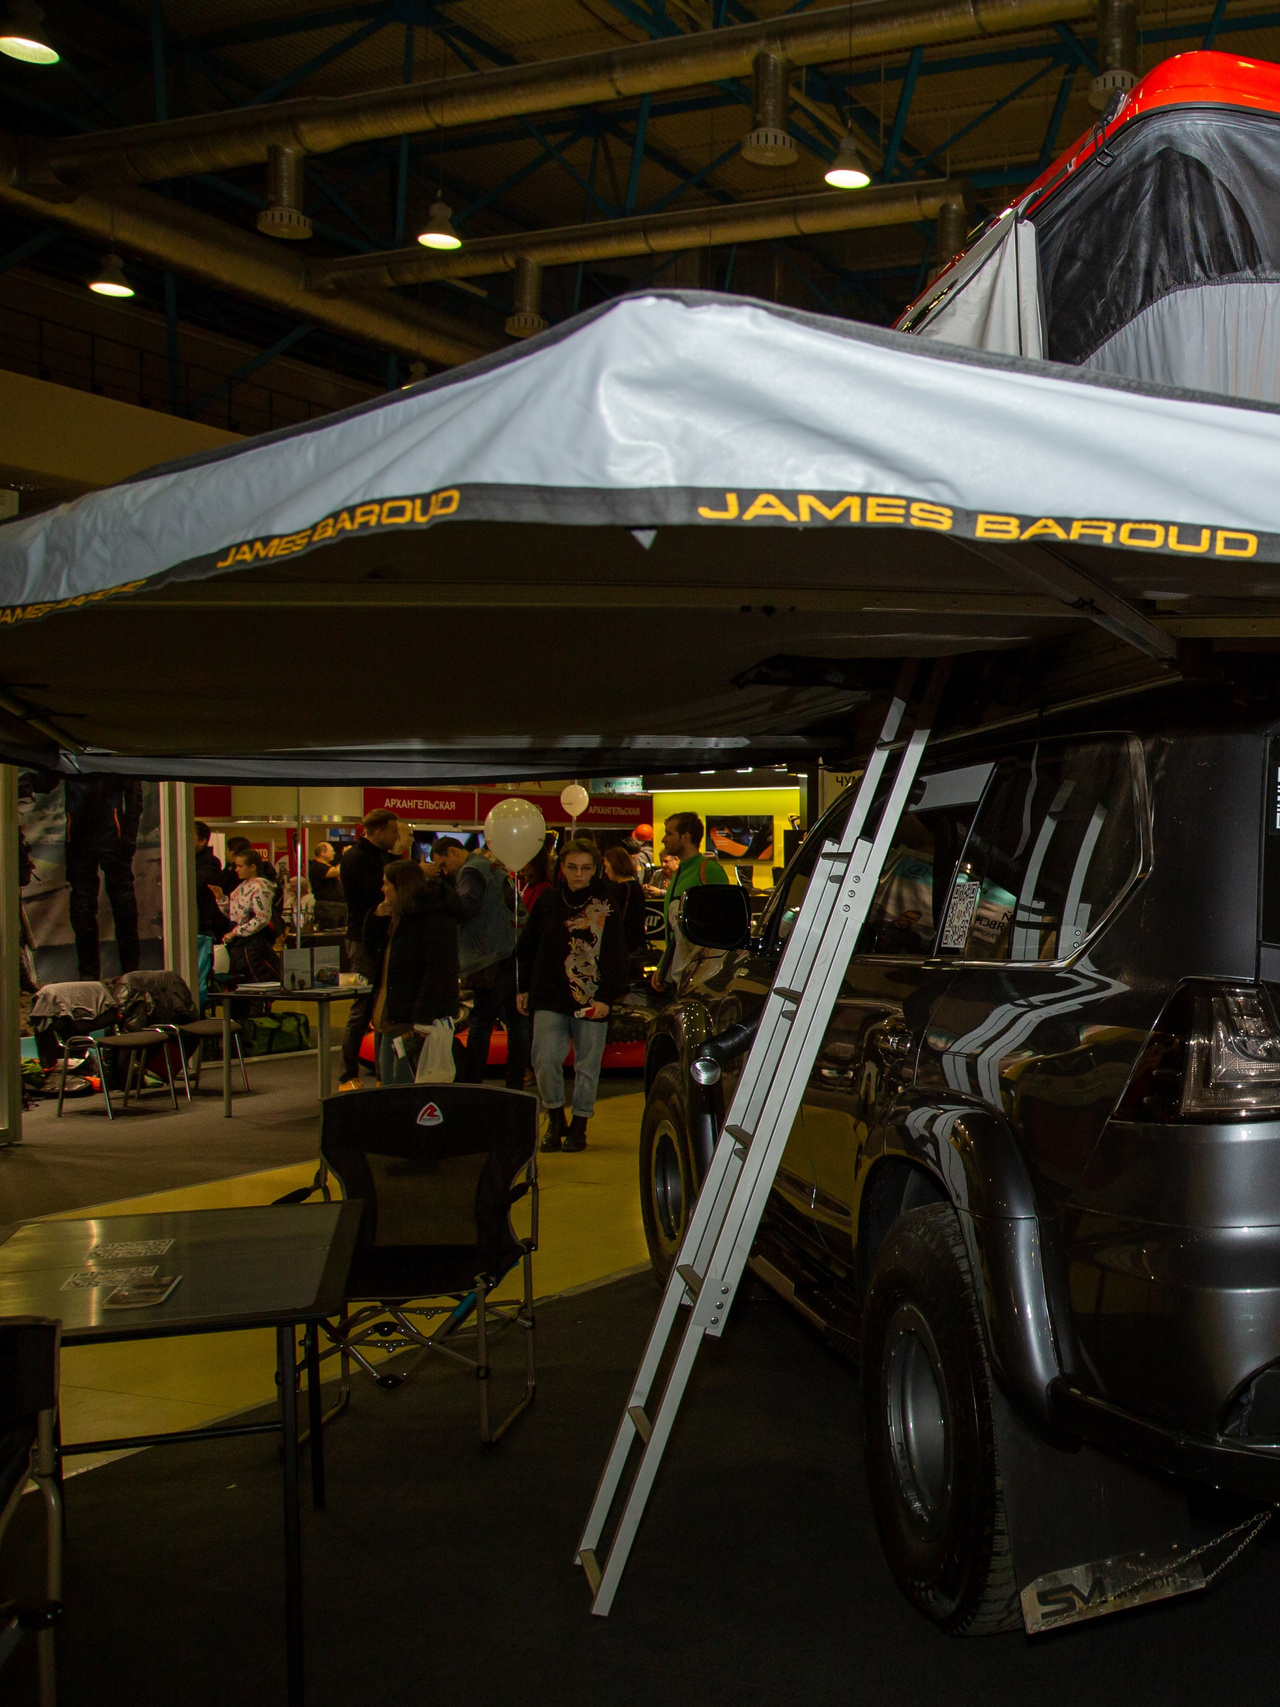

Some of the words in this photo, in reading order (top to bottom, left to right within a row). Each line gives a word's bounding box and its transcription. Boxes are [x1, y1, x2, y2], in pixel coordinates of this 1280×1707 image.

[217, 530, 309, 568] JAMES
[311, 489, 460, 543] BAROUD
[698, 492, 953, 531] JAMES
[975, 513, 1258, 558] BAROUD
[384, 798, 456, 811] АРХАНГЕЛЬСКАЯ
[588, 806, 640, 815] АРХАНГЕЛЬСКАЯ
